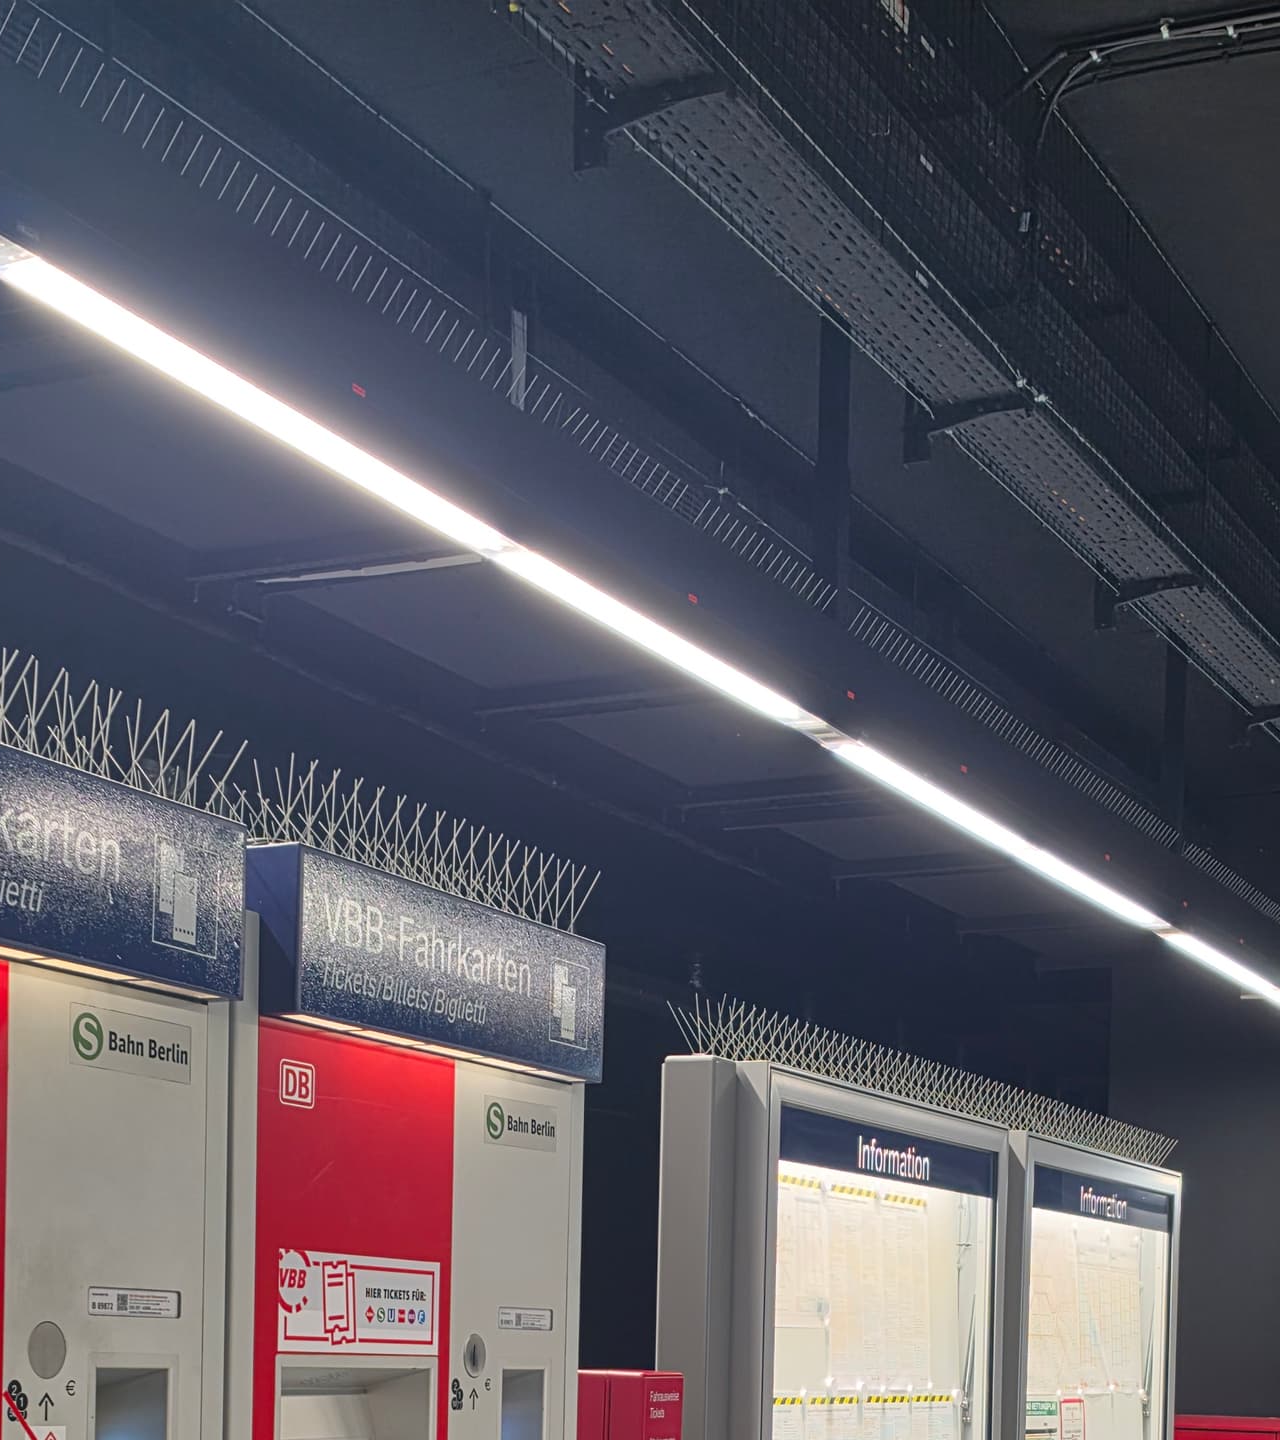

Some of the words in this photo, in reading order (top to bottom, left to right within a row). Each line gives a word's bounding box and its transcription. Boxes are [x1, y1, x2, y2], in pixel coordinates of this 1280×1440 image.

[325, 895, 531, 997] VBB-Fahrkarten
[321, 960, 487, 1024] Tickets/Billets/Biglietti
[76, 1015, 101, 1058] S
[108, 1031, 144, 1056] Bahn
[148, 1038, 188, 1065] Berlin
[283, 1065, 312, 1102] DB
[488, 1103, 503, 1138] S
[507, 1114, 529, 1135] Bahn
[531, 1119, 555, 1139] Berlin
[857, 1135, 930, 1181] Information
[1080, 1186, 1127, 1219] Information
[279, 1268, 307, 1289] VBB
[365, 1288, 382, 1299] HIER
[383, 1289, 411, 1301] TICKETS
[411, 1288, 427, 1302] FÜR:
[66, 1380, 76, 1396] €
